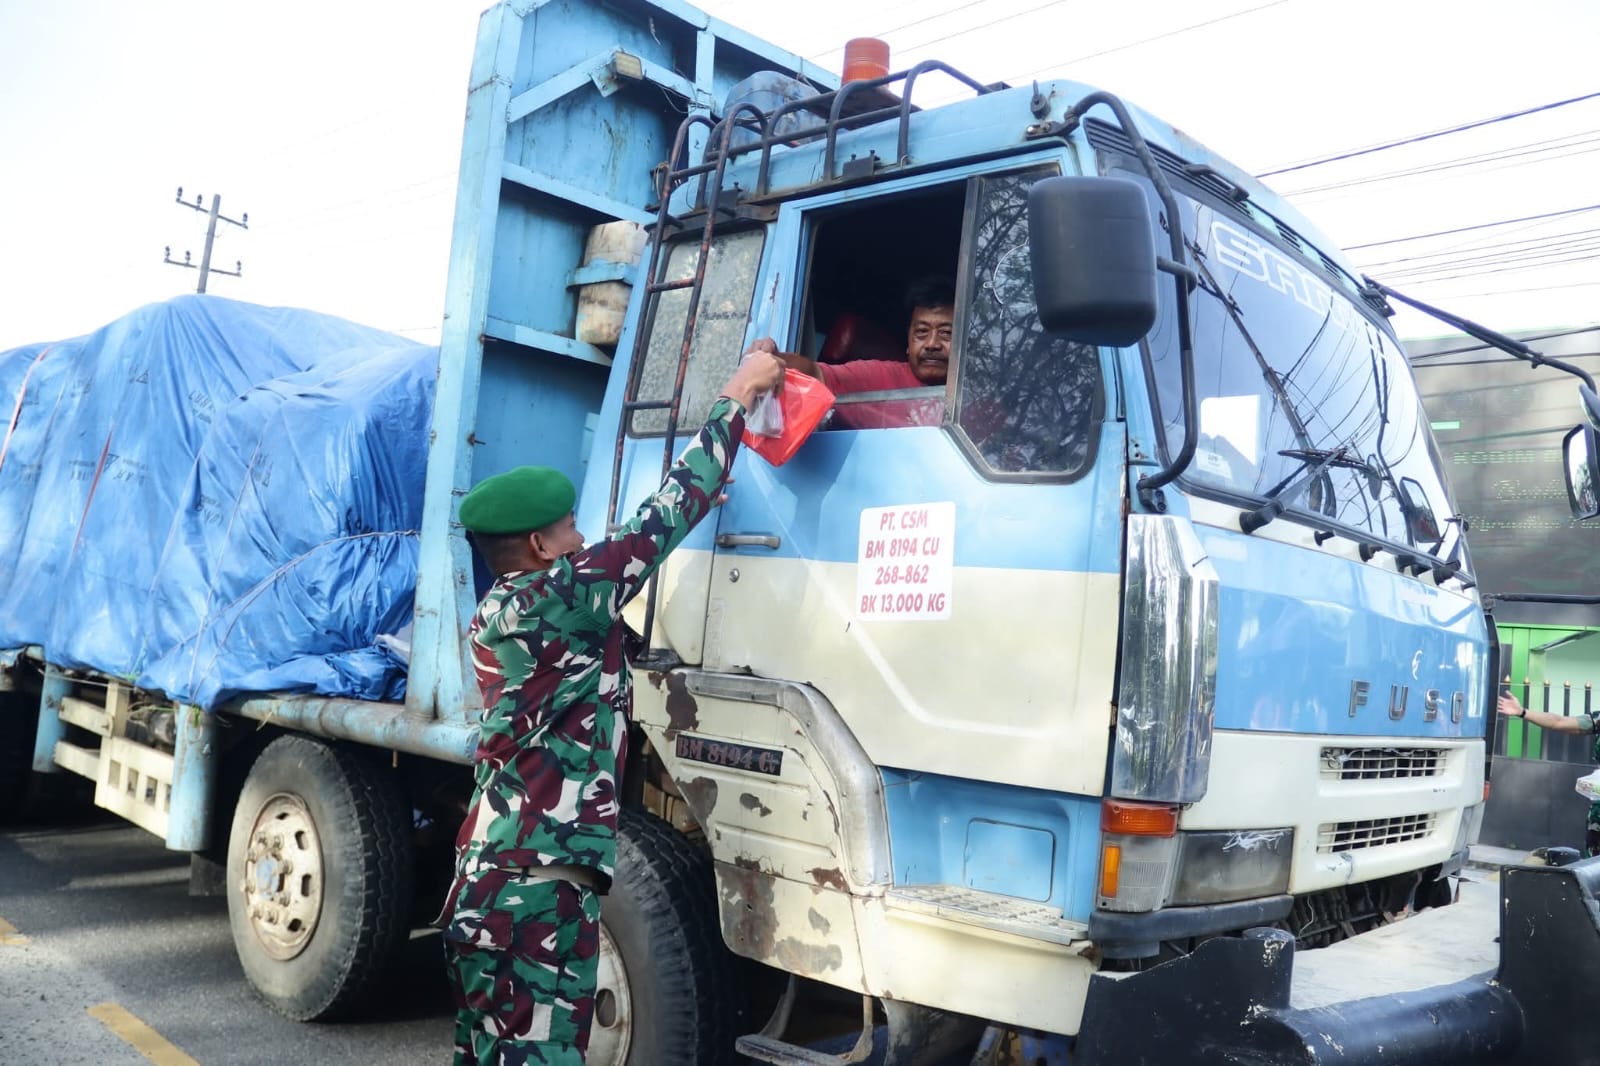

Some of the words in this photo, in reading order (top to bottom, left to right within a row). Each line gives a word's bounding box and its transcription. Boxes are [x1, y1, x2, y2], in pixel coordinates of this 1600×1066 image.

[880, 511, 896, 531] PT.
[901, 509, 928, 530] CSM
[865, 540, 885, 559] BM
[889, 538, 918, 557] 8194
[922, 537, 940, 556] CU
[875, 564, 930, 585] 268-862
[860, 594, 877, 613] BK
[881, 592, 923, 613] 13.000
[927, 592, 945, 612] KG
[1348, 680, 1465, 724] FUSO
[677, 736, 704, 760] BM
[707, 743, 753, 769] 8194
